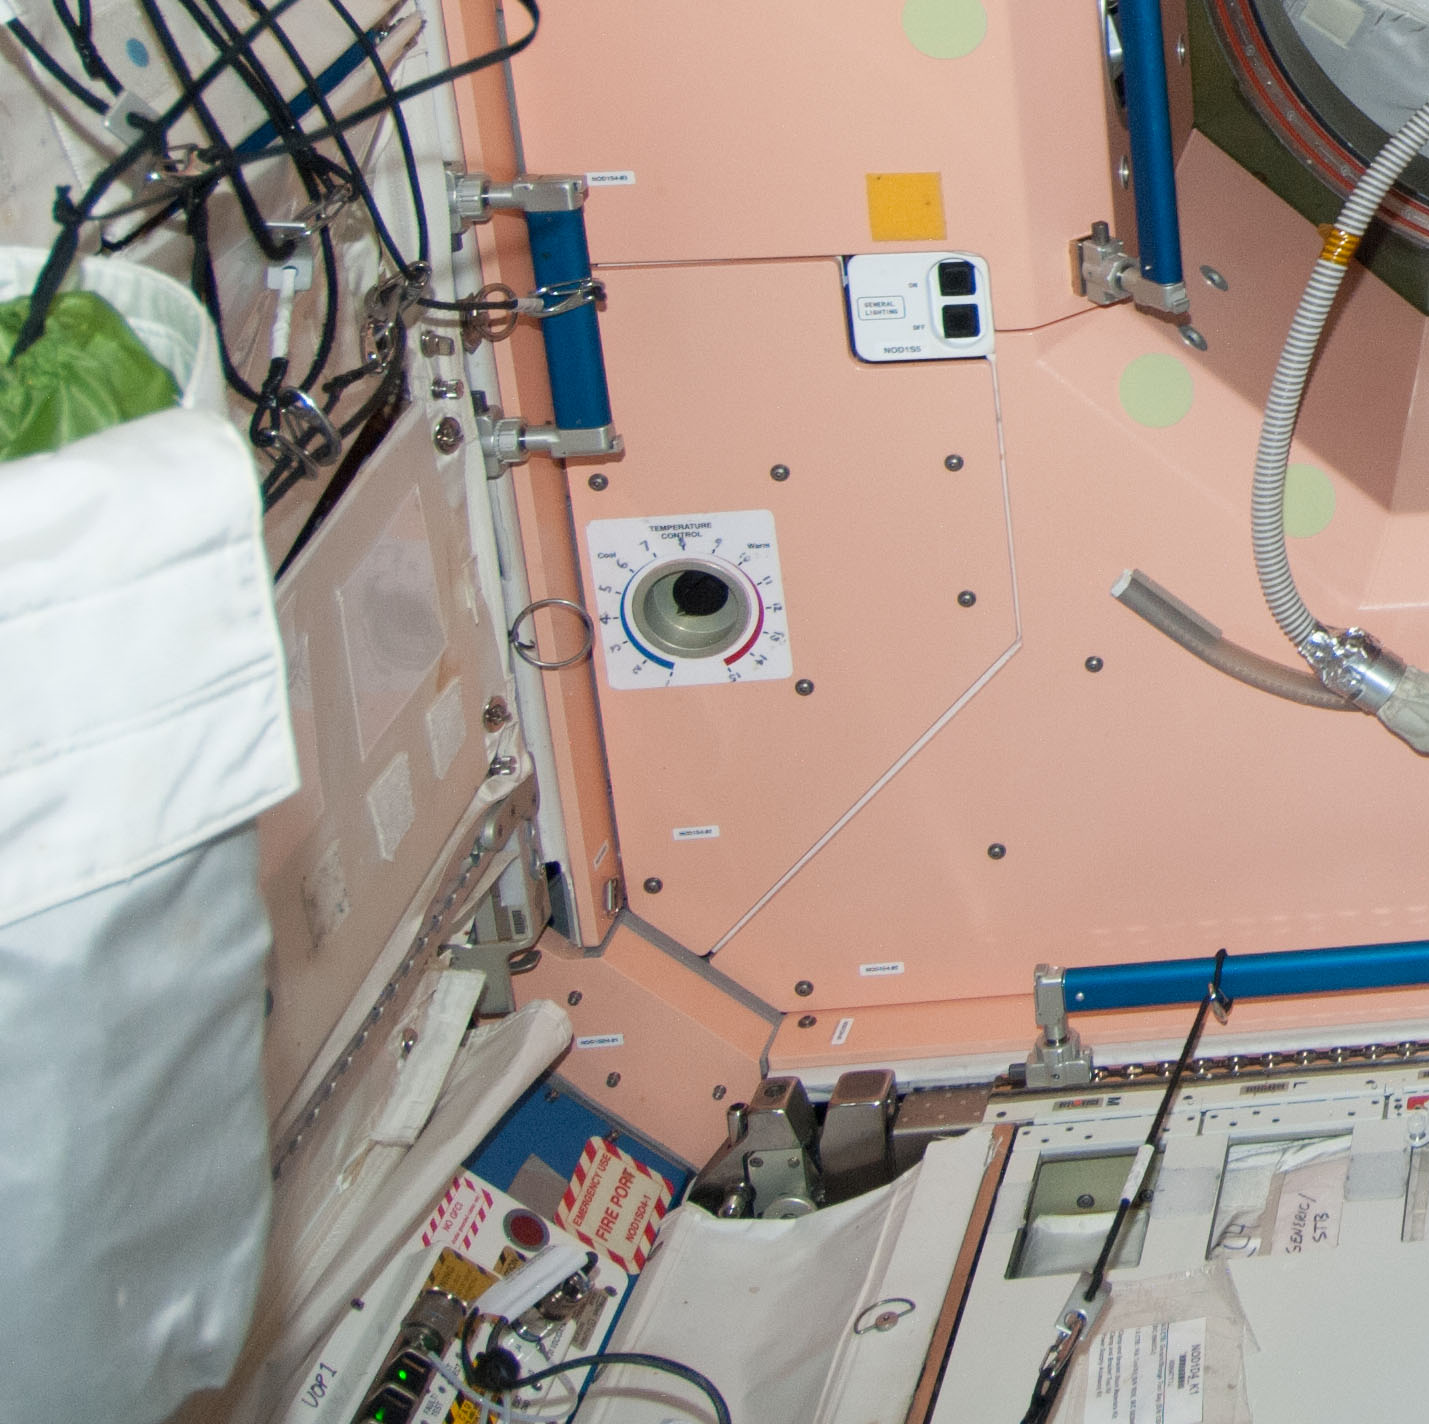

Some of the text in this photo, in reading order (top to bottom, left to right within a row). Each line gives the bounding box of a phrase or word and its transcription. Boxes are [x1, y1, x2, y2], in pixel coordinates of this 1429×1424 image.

[883, 345, 922, 354] NOD1S5
[648, 522, 712, 533] TEMPERATURE
[660, 531, 703, 540] CONTROL
[573, 1153, 612, 1227] EMERGENCY USE
[595, 1167, 636, 1243] FIRE PORT
[442, 1219, 453, 1233] NO
